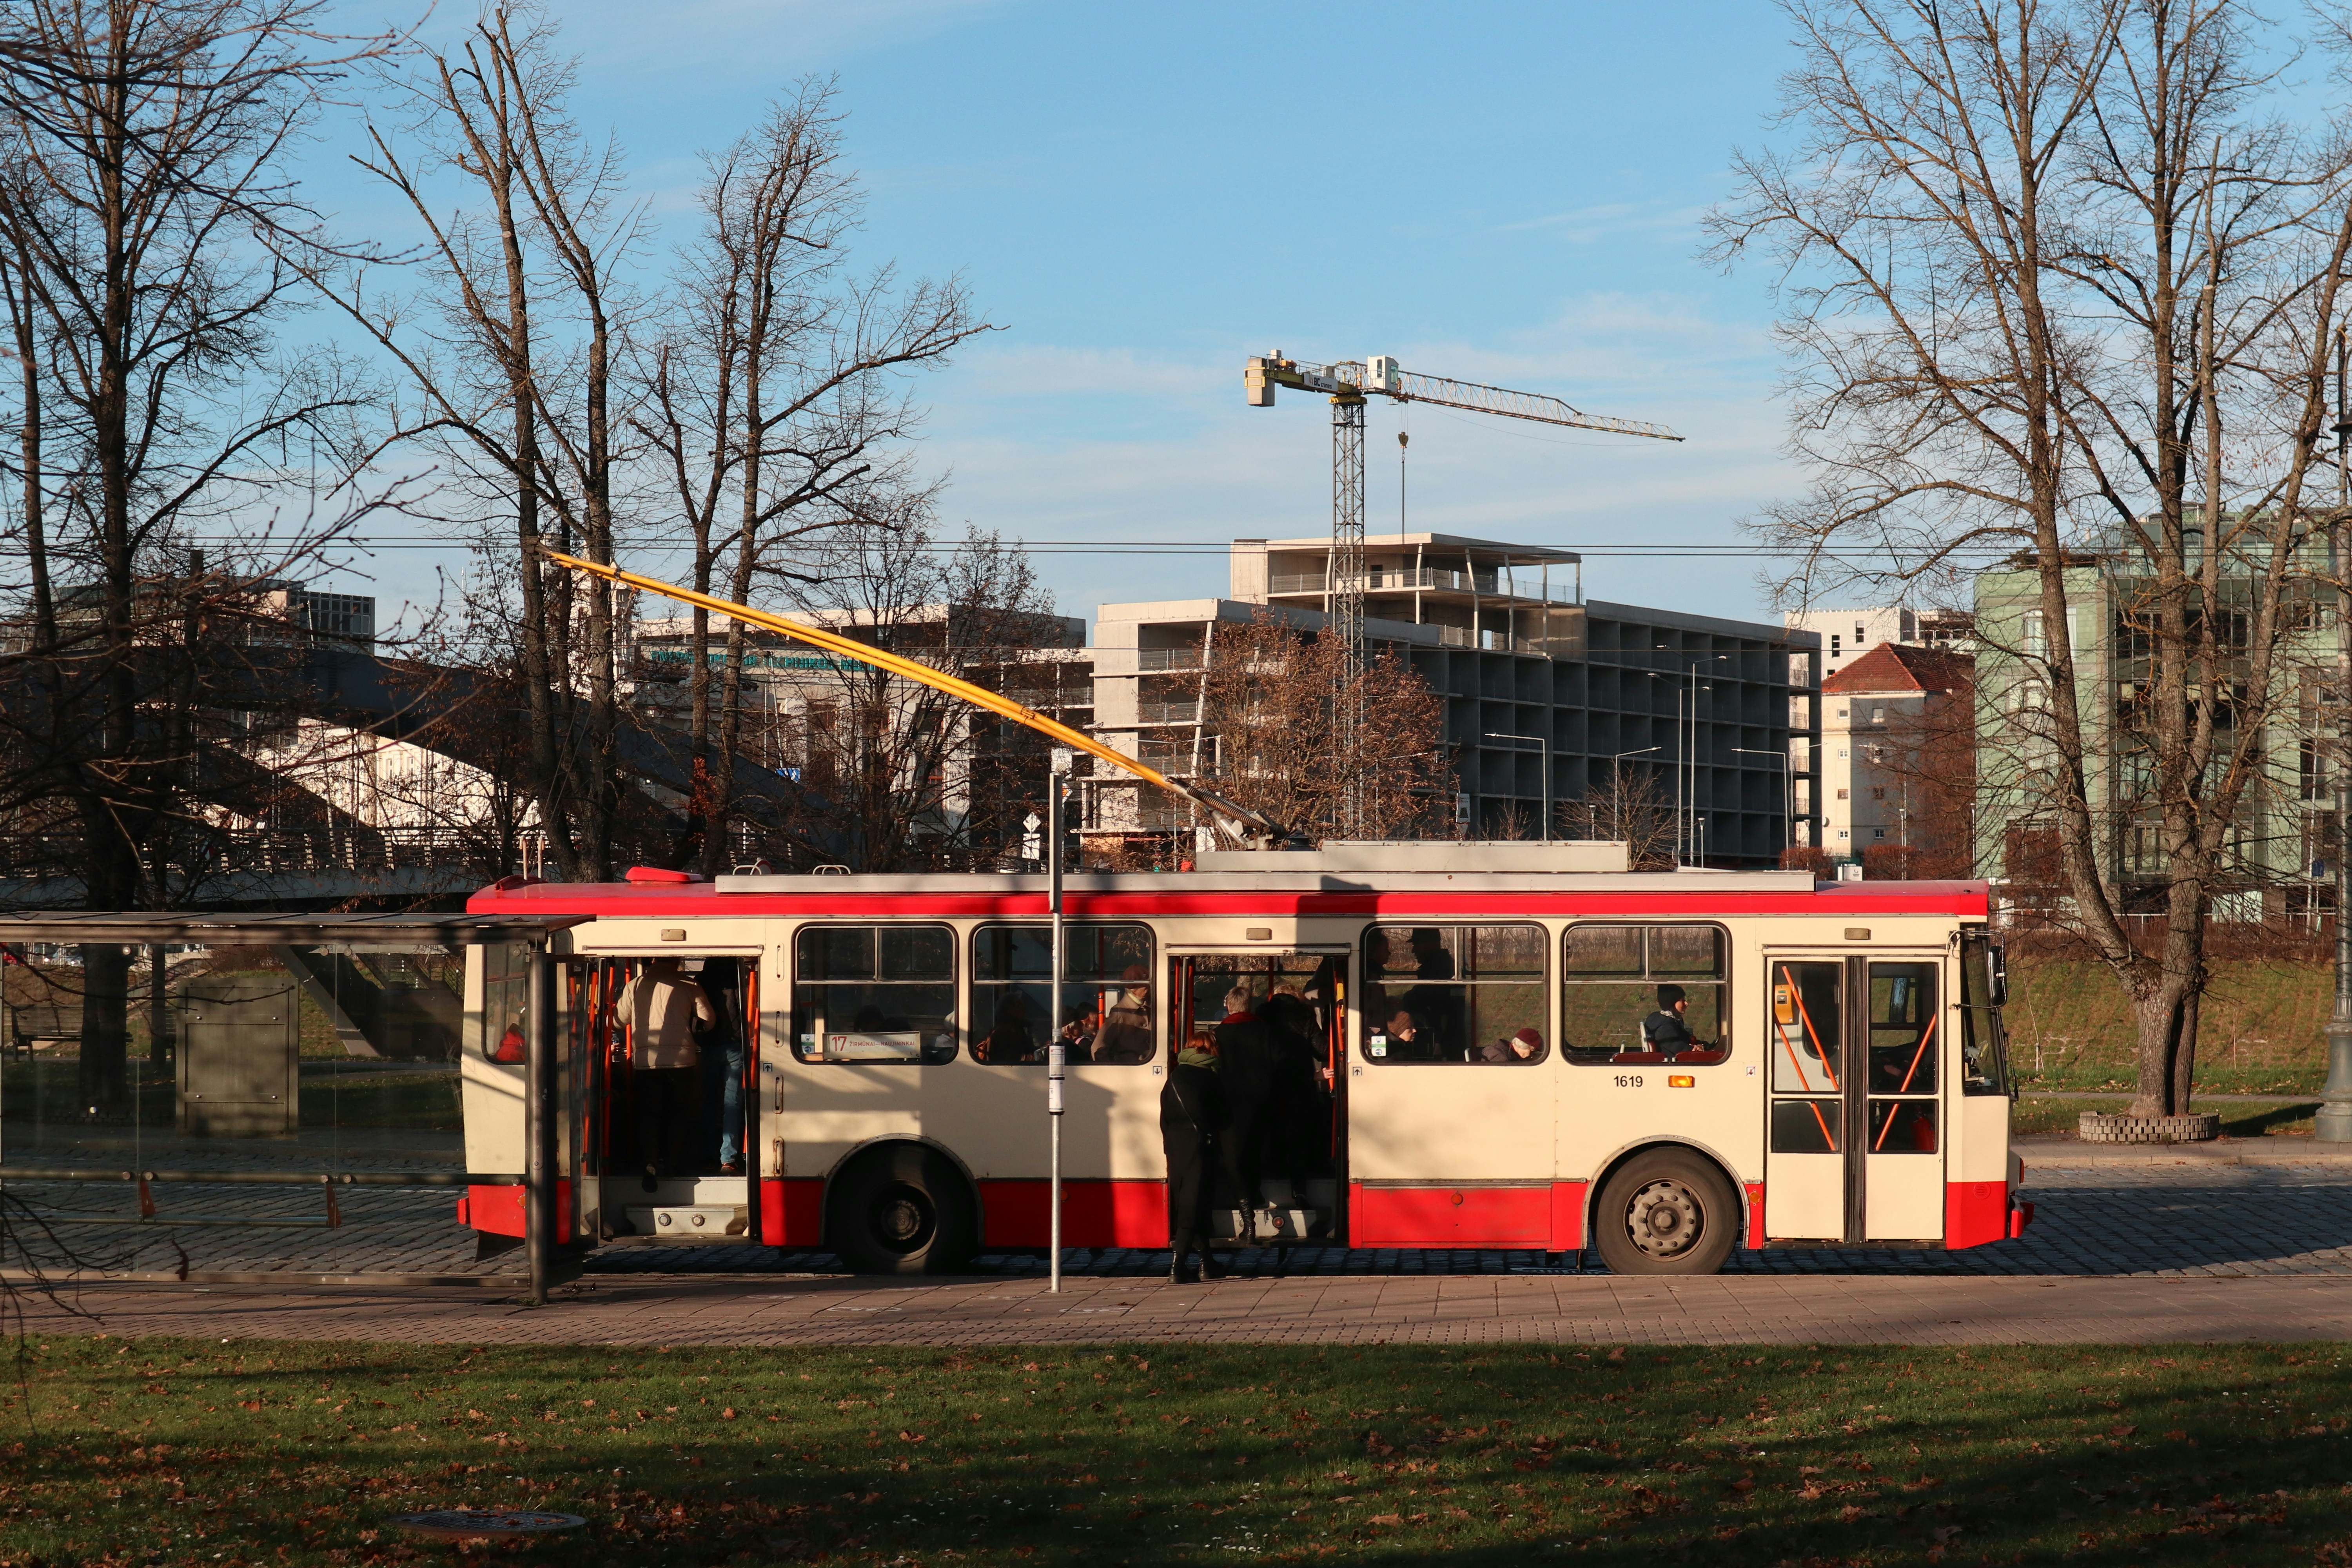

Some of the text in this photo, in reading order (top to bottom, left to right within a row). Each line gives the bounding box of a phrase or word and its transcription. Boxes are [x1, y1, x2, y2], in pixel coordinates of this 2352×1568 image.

[1314, 377, 1320, 387] BC
[831, 1036, 847, 1052] 17
[1613, 1075, 1643, 1087] 1619
